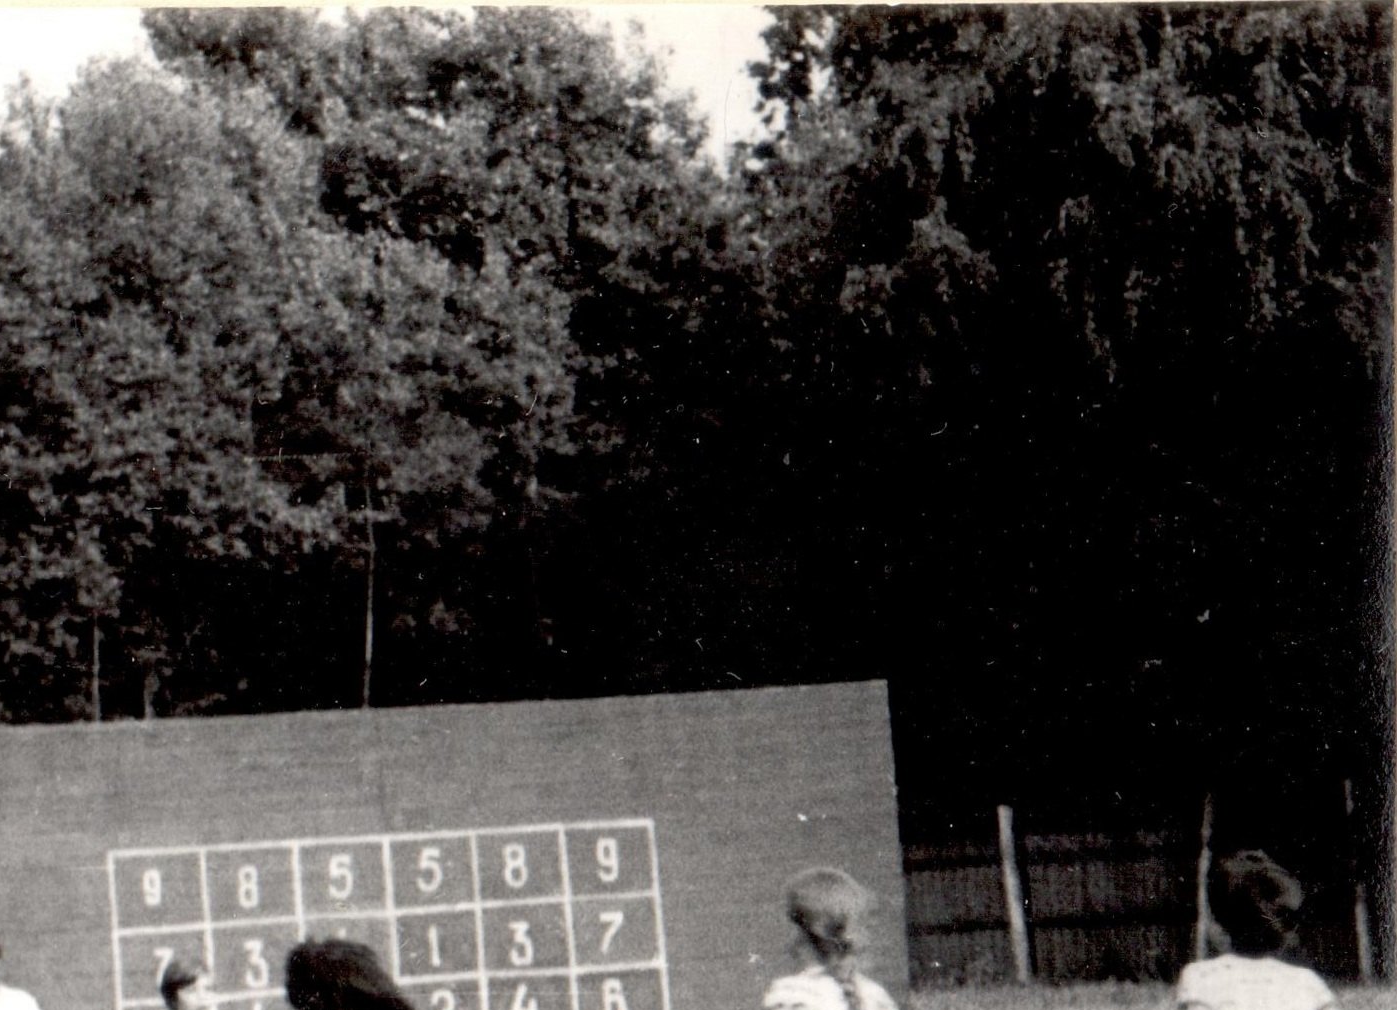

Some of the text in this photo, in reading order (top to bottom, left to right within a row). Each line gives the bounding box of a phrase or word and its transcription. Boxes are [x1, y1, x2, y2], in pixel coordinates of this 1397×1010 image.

[142, 838, 619, 907] 9 8 5 5 8 9
[153, 911, 623, 988] 7 3 1 3 7
